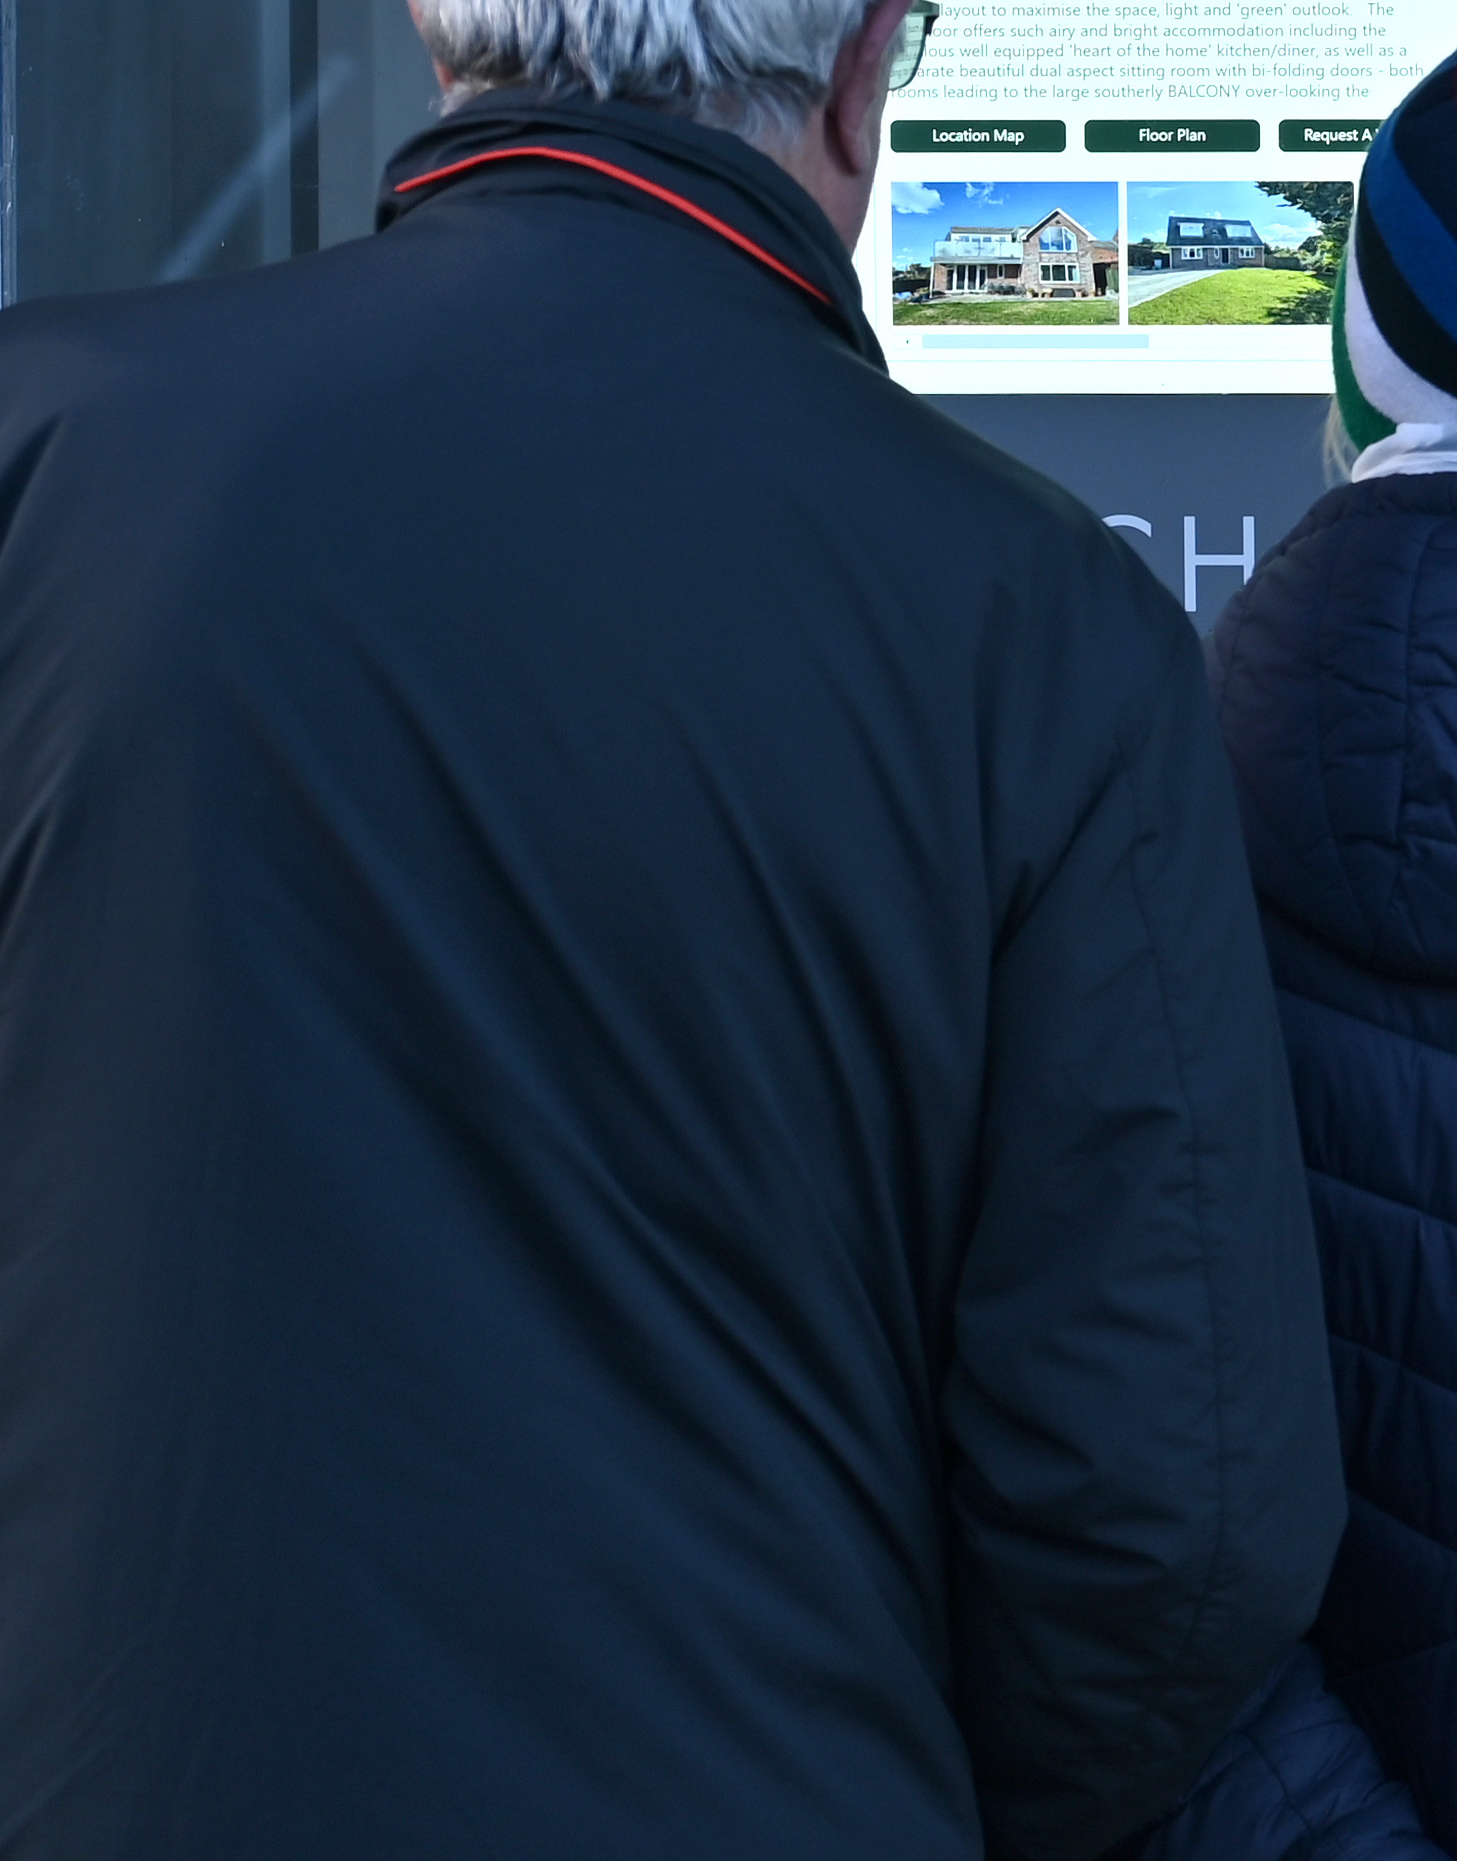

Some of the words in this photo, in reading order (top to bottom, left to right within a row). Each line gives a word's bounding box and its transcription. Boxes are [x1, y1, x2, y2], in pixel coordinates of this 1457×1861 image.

[932, 127, 990, 142] Location
[993, 128, 1025, 146] Map
[1138, 127, 1175, 142] Floor
[1176, 127, 1207, 142] Plan
[1303, 127, 1359, 145] Request
